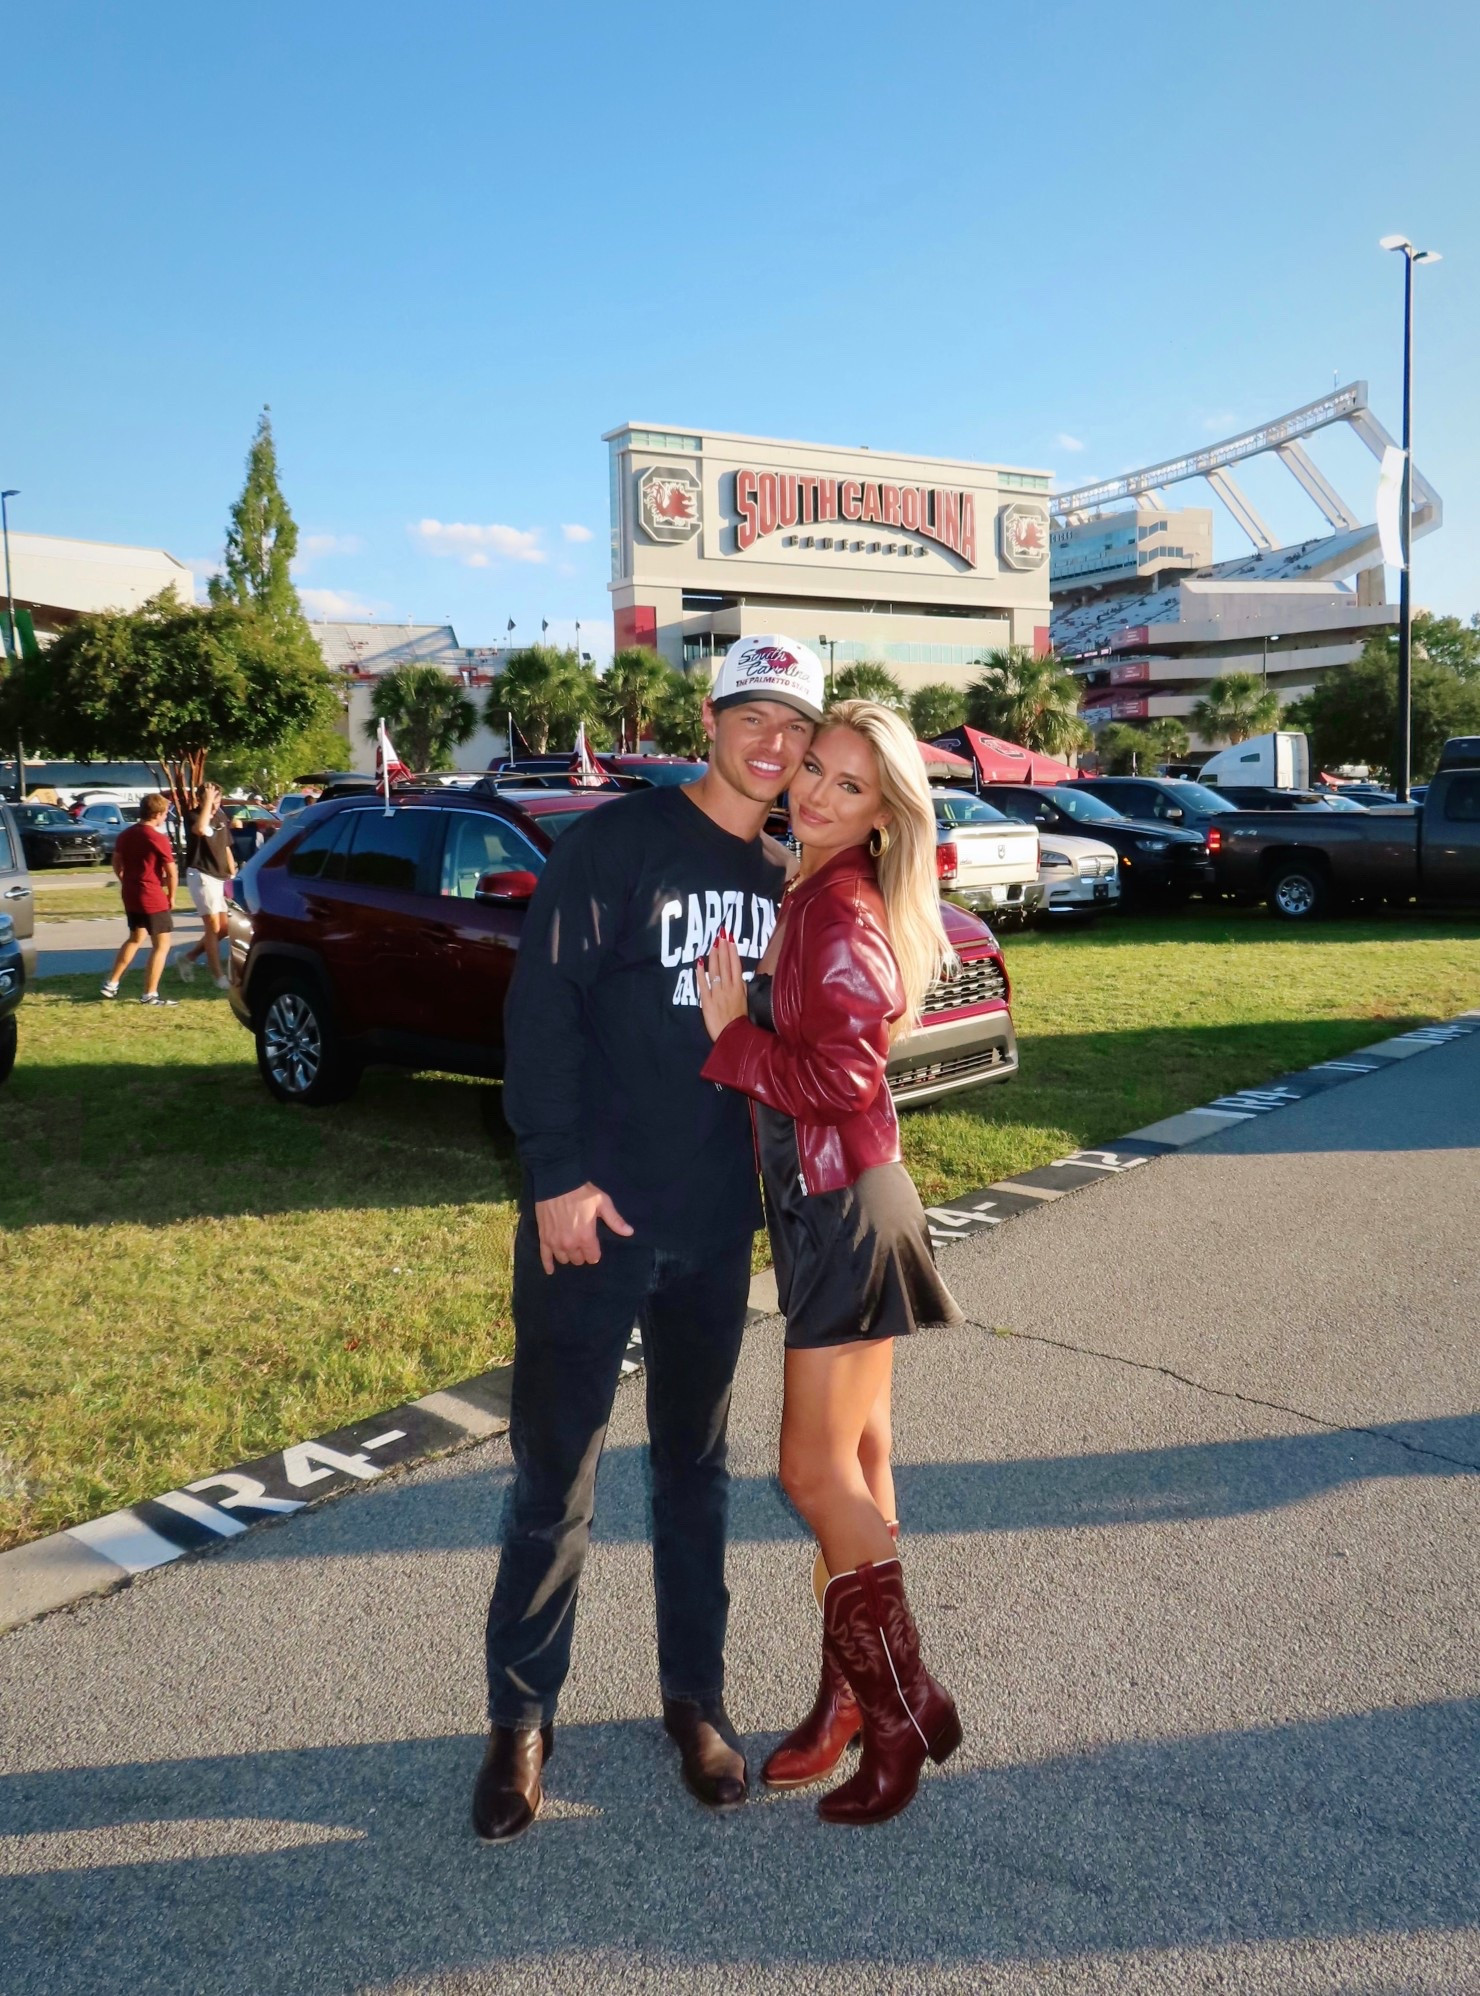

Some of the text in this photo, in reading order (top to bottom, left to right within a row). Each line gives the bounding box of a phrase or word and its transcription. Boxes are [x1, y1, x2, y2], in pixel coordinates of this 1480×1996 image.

[736, 468, 977, 569] SOUTH CAROLINA
[790, 534, 930, 557] GAMECOCKS
[738, 646, 787, 665] South
[736, 679, 748, 688] THE
[748, 675, 790, 687] PALMETTO
[746, 660, 811, 681] Carolina
[660, 890, 778, 968] CAROLIN
[1051, 1150, 1148, 1173] 12
